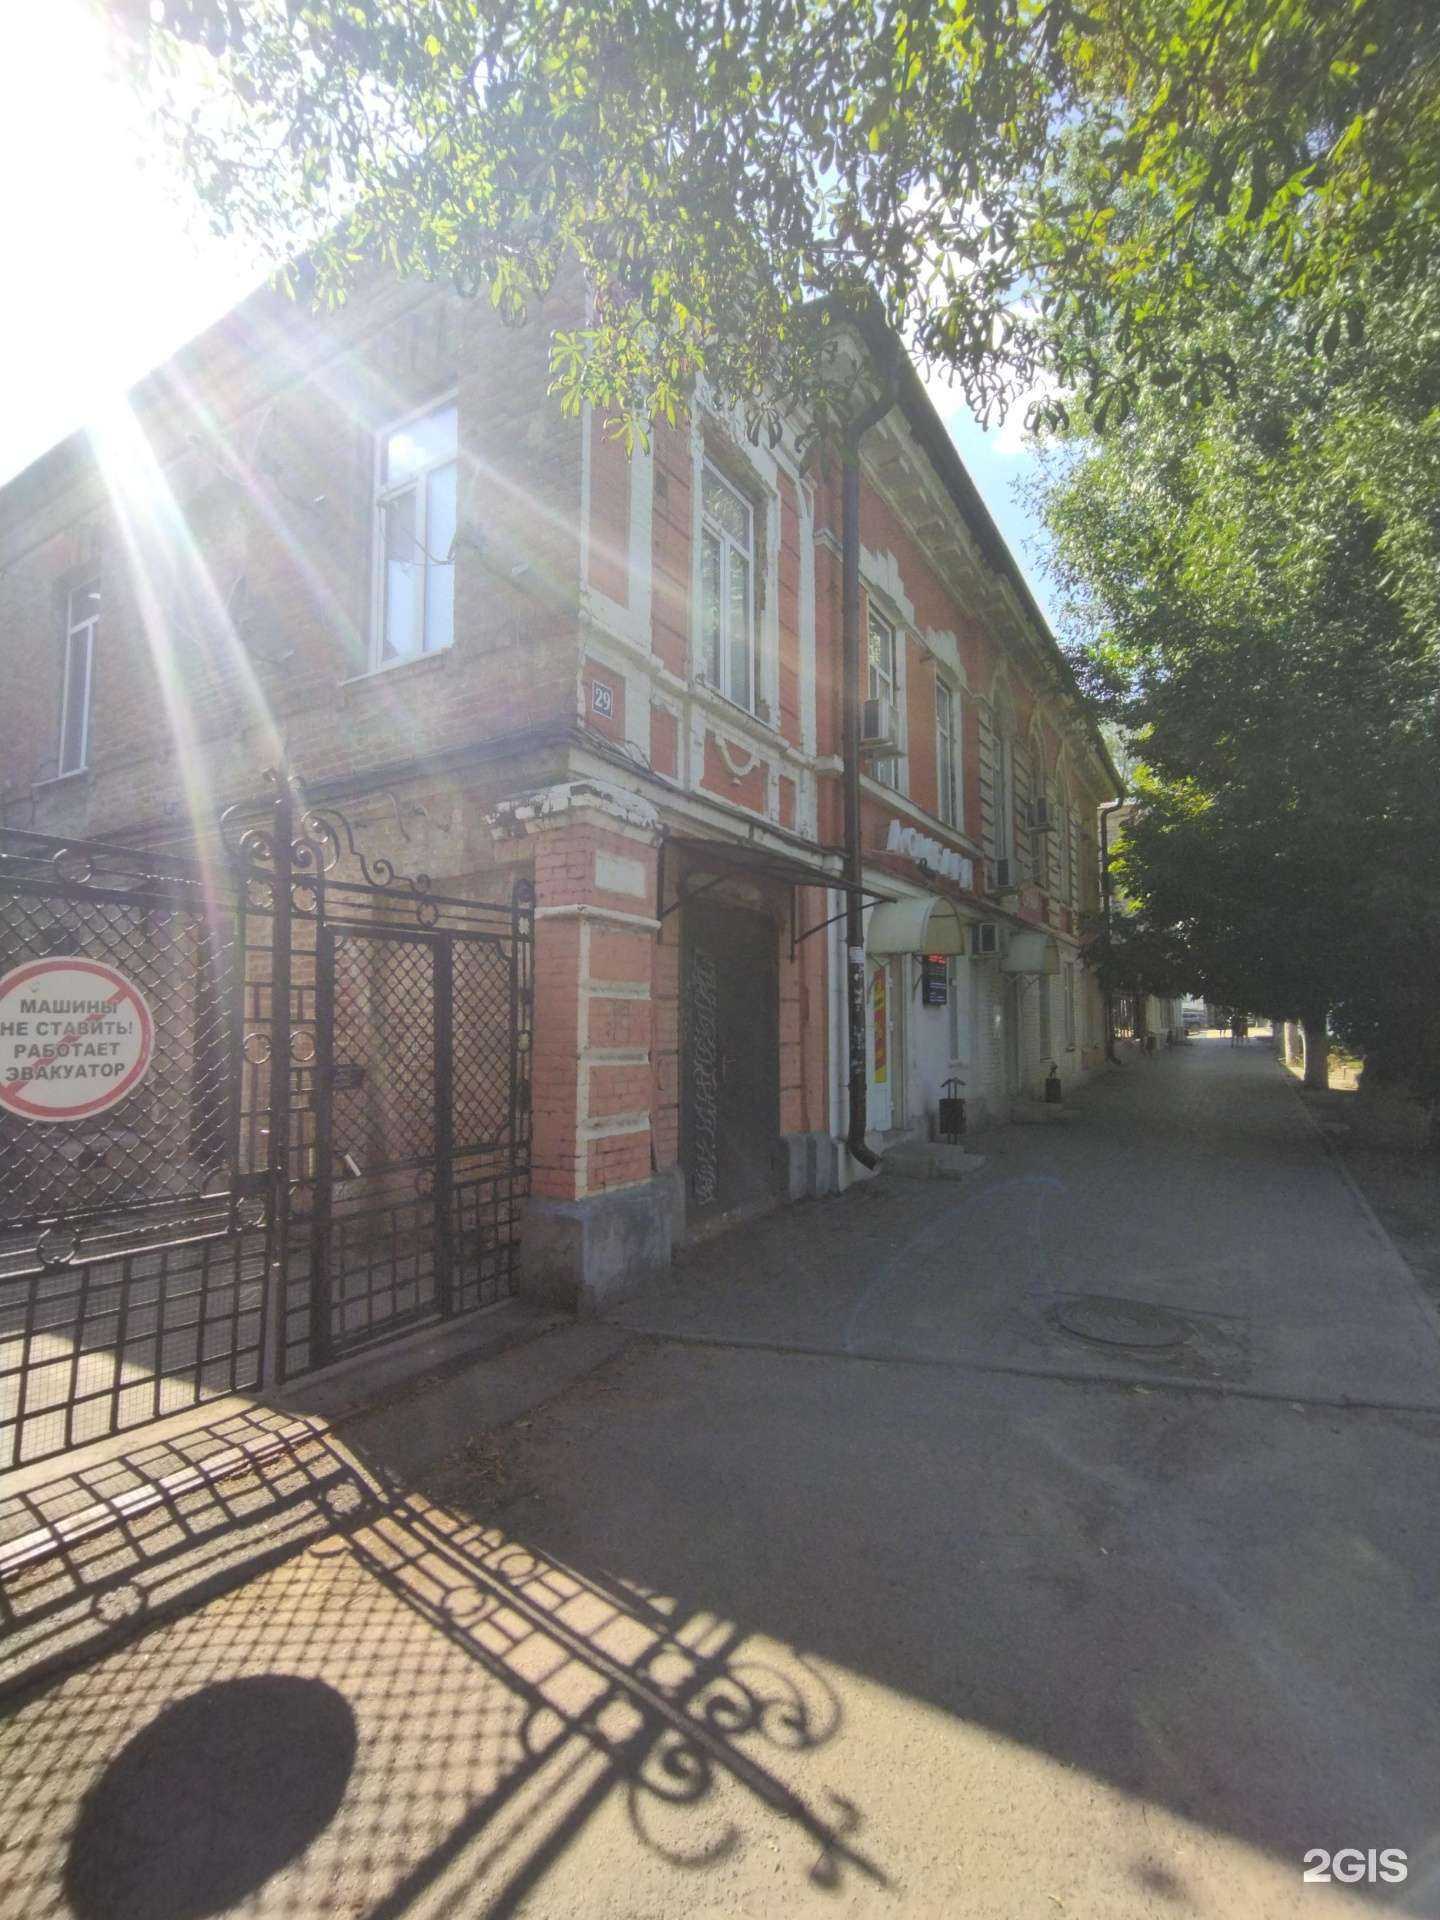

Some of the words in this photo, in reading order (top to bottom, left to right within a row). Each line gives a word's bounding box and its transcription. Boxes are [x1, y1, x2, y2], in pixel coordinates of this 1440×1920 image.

[595, 688, 611, 710] 29
[20, 1000, 117, 1014] МАШИНЫ
[0, 1022, 28, 1036] НЕ
[35, 1021, 133, 1036] СТАВИТЬ!
[13, 1042, 120, 1059] РАБОТАЕТ
[5, 1063, 125, 1081] ЭВАКУАТОР
